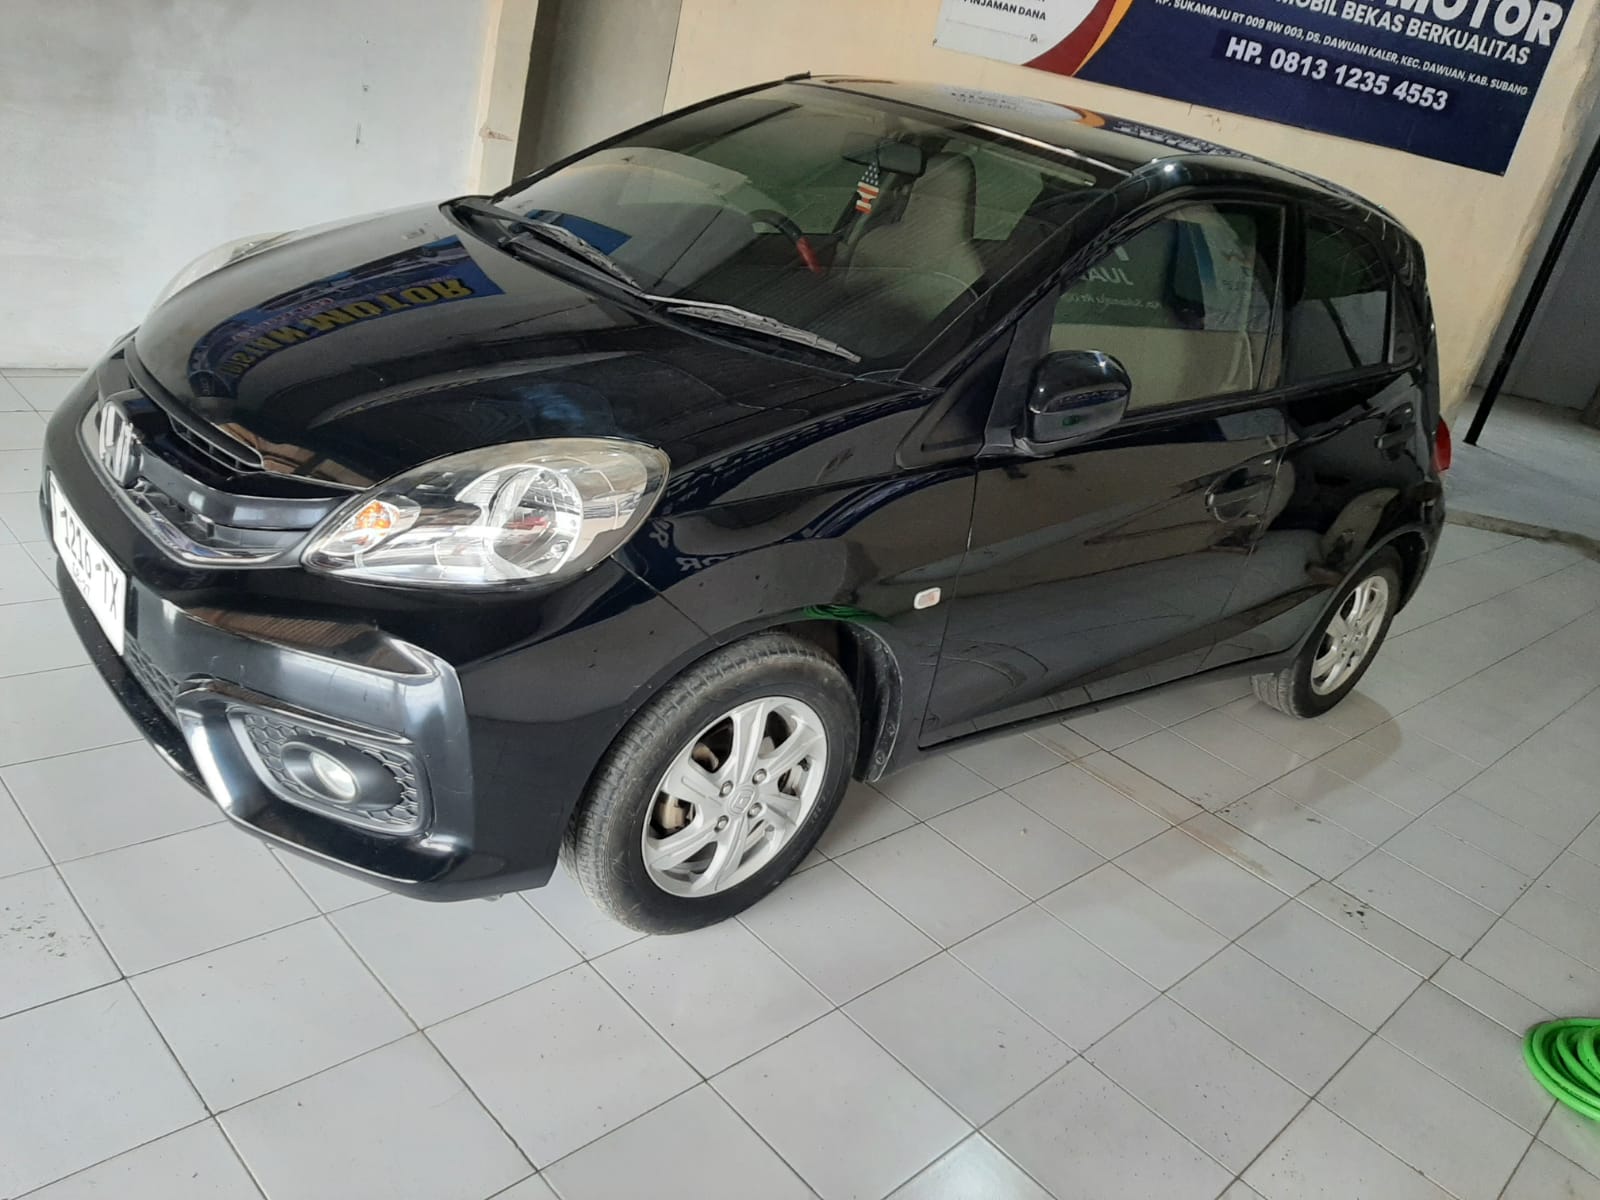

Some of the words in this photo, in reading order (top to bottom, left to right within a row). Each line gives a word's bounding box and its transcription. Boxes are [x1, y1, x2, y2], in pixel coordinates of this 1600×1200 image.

[963, 0, 1017, 14] NJAMAN
[1018, 6, 1046, 20] DANA
[1173, 0, 1232, 20] SUKAMAJU
[1231, 12, 1245, 24] RT
[1245, 15, 1265, 29] 009
[1265, 20, 1284, 34] RW
[1283, 24, 1304, 40] 003,
[1306, 30, 1321, 44] DS.
[1323, 35, 1368, 55] DAWUAN
[1367, 46, 1399, 64] KALER,
[1400, 55, 1421, 69] KEC.
[1422, 61, 1467, 82] DAWUAN,
[1467, 72, 1488, 87] KAB.
[1341, 1, 1405, 33] BEKAS
[1405, 17, 1531, 65] BERKUALITAS
[1225, 36, 1262, 65] HP.
[1269, 47, 1328, 80] 0813
[1334, 64, 1390, 96] 1235
[1392, 80, 1449, 111] 4553
[64, 507, 92, 580] 1216
[102, 558, 119, 621] TX
